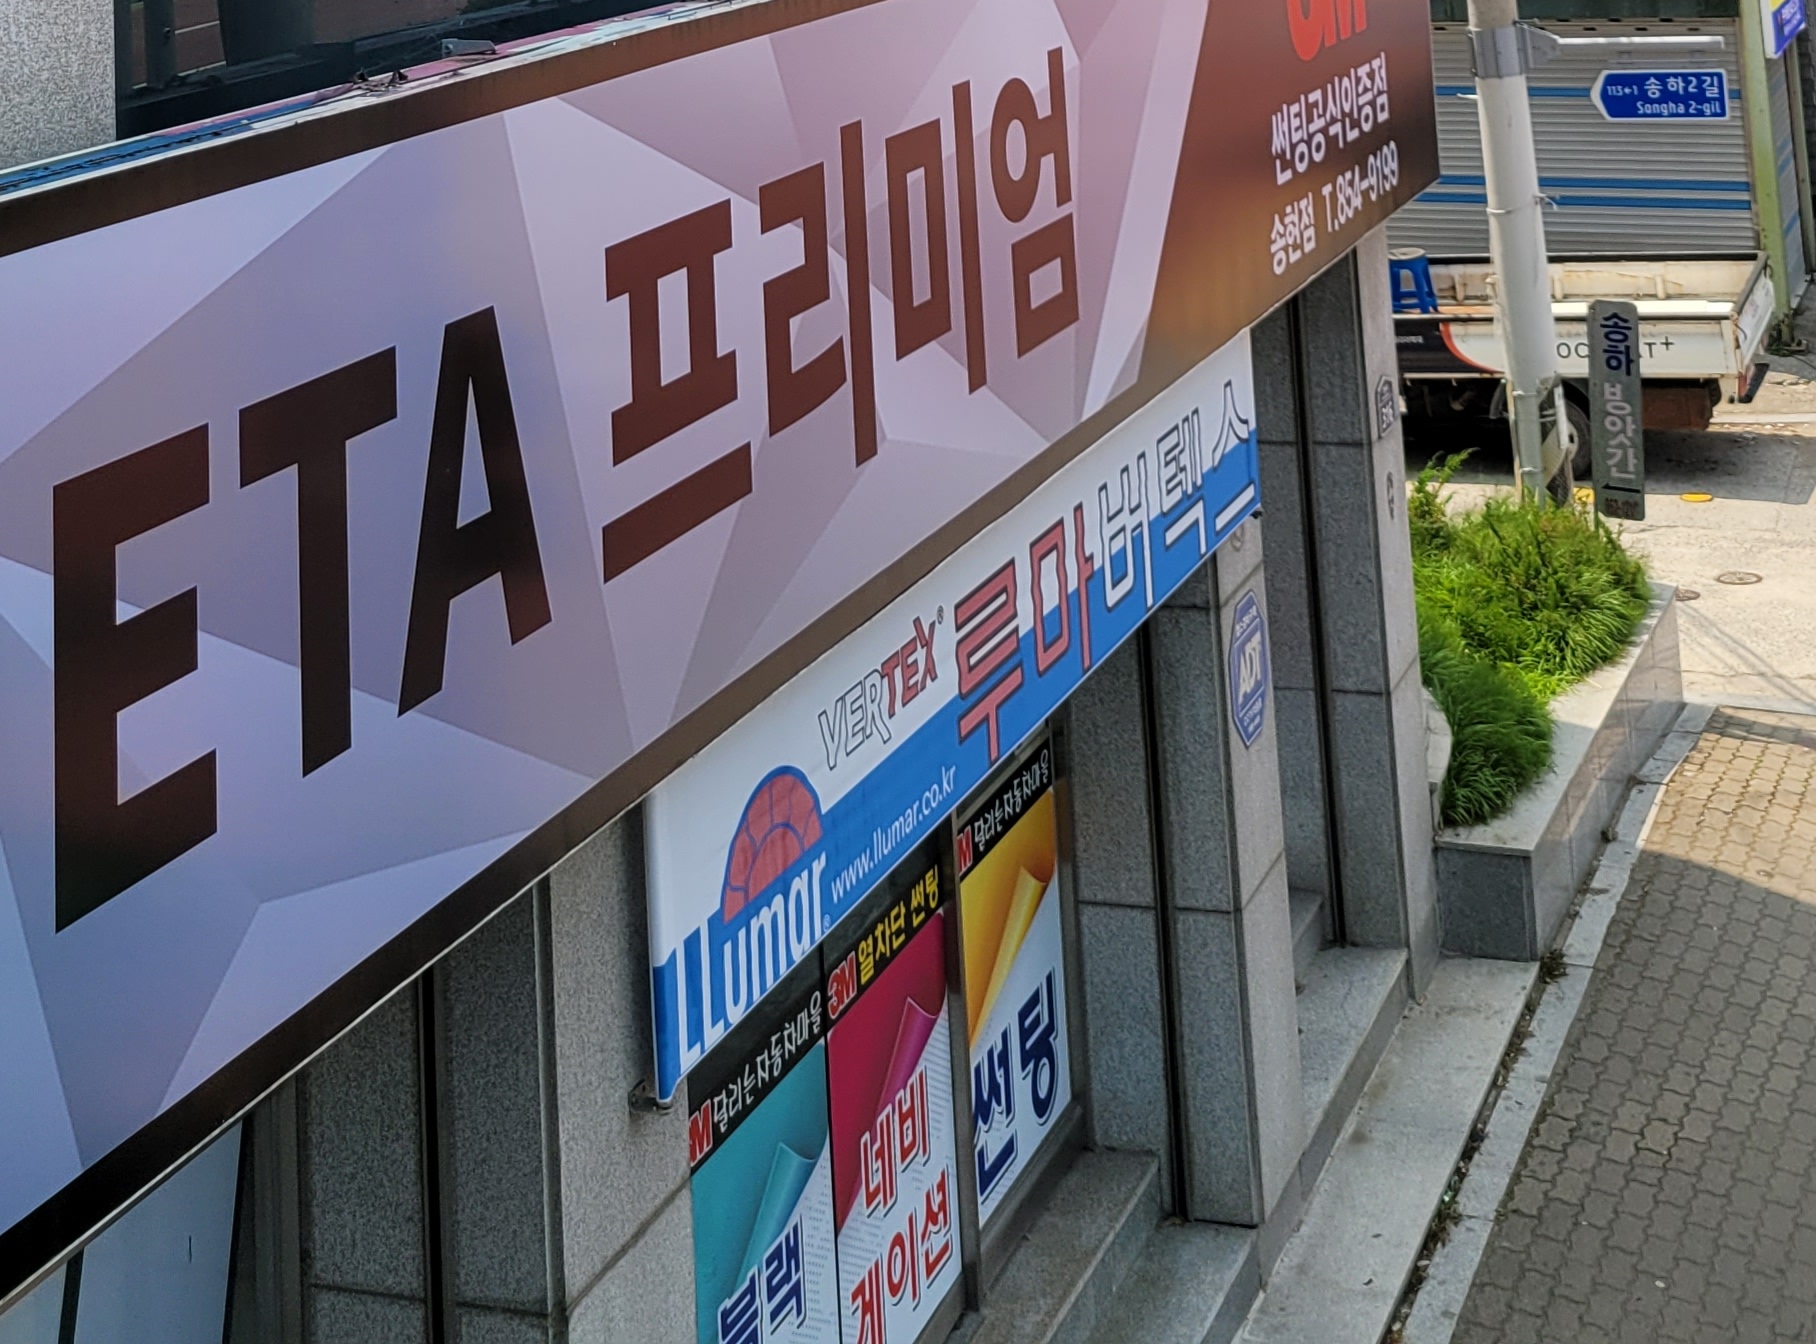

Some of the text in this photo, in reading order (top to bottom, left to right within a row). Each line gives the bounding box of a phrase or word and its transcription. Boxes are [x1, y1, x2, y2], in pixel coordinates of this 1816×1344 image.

[1271, 52, 1390, 186] 썬팅공식인증점
[1636, 100, 1722, 116] Songha 2-gil
[1643, 76, 1720, 99] 송하2길
[1269, 139, 1400, 276] 송현점 T.854-9199
[602, 47, 1080, 585] 프리미엄
[1600, 312, 1632, 376] 송하
[1603, 382, 1638, 480] 방앗간
[54, 305, 552, 934] ETA
[954, 379, 1255, 765] 루마버텍스
[818, 616, 939, 771] VERTEX
[1239, 630, 1262, 705] ADT
[830, 765, 957, 905] www.llumar.co.kr
[828, 864, 940, 1020] 3M 열차단 썬팅
[861, 1069, 930, 1212] 네비
[973, 968, 1058, 1205] 썬팅
[851, 1169, 951, 1344] 게이션
